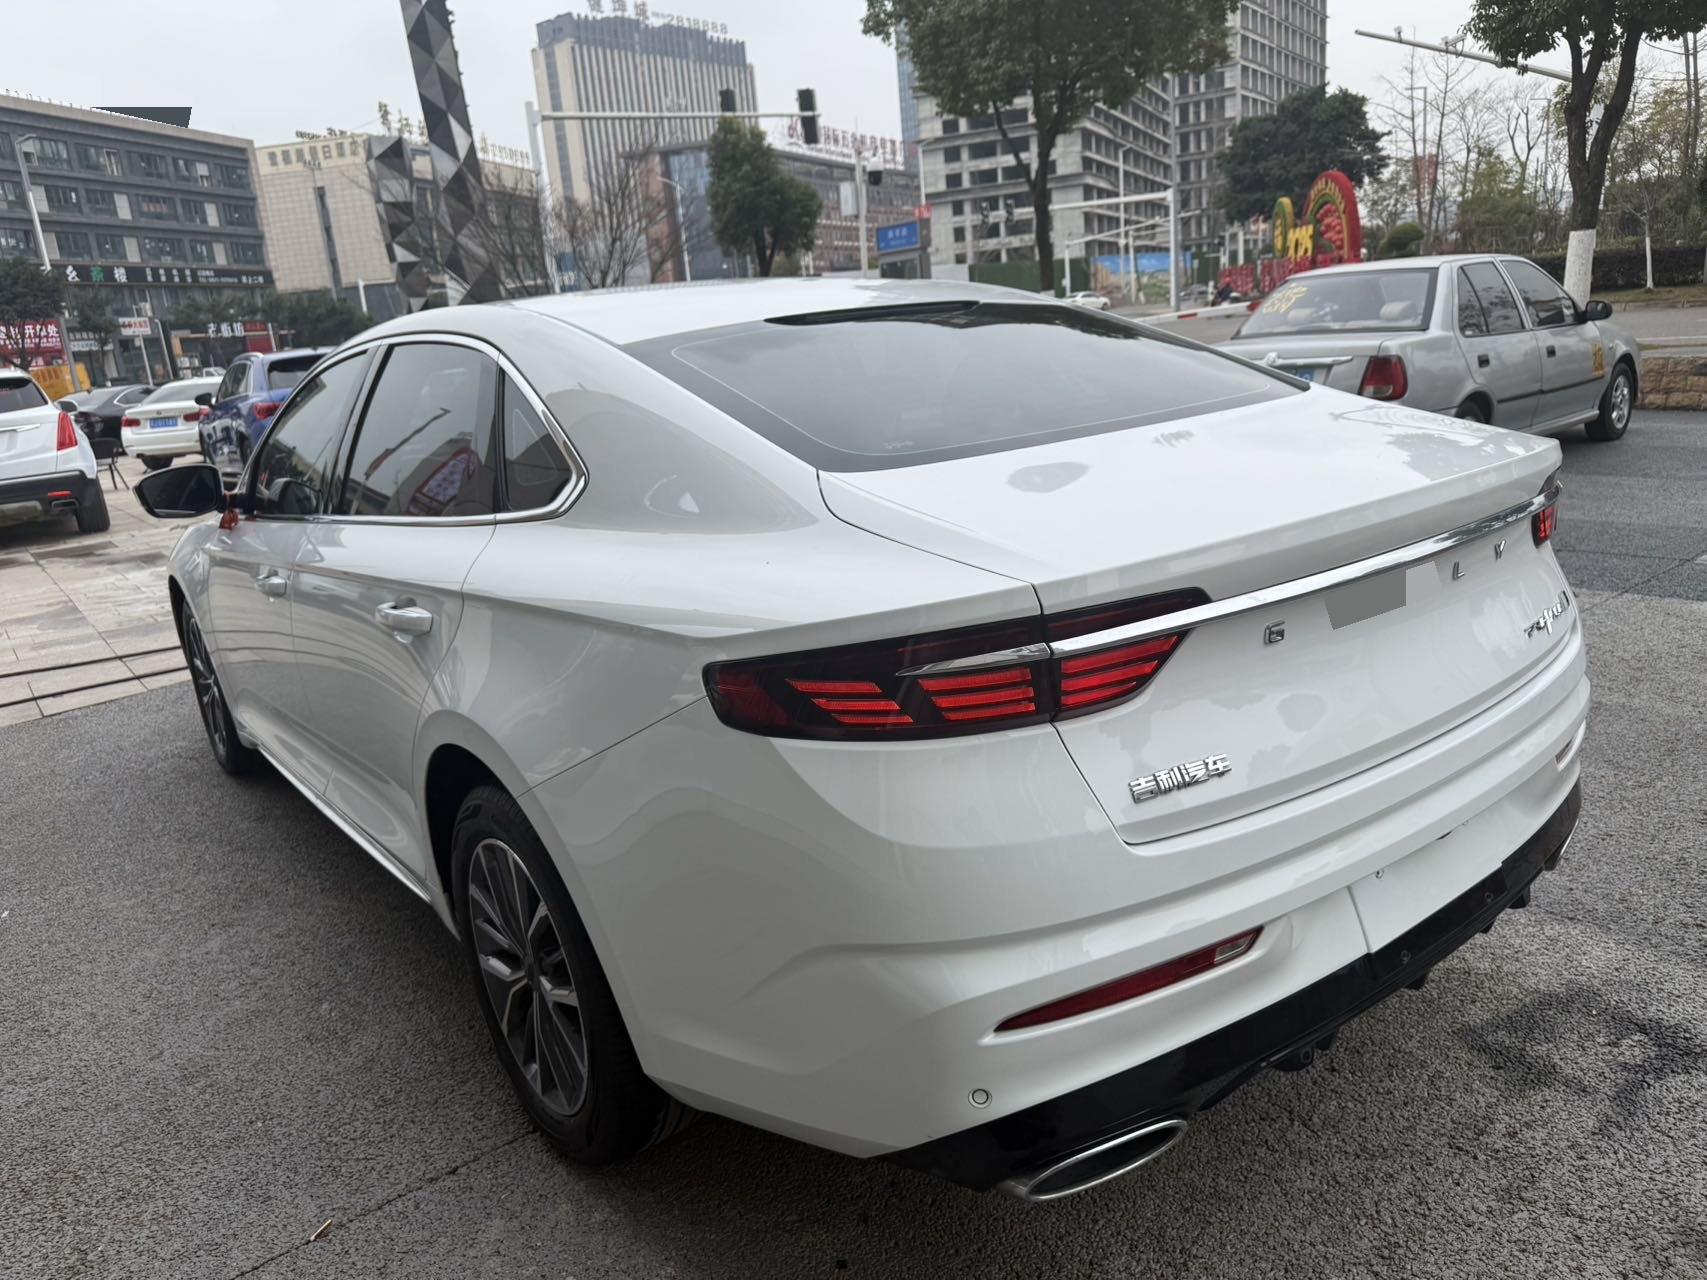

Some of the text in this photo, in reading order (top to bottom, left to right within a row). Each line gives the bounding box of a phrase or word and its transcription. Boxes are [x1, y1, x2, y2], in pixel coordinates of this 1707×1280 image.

[1263, 538, 1508, 646] GLY
[1127, 753, 1233, 804] 吉利汽车
